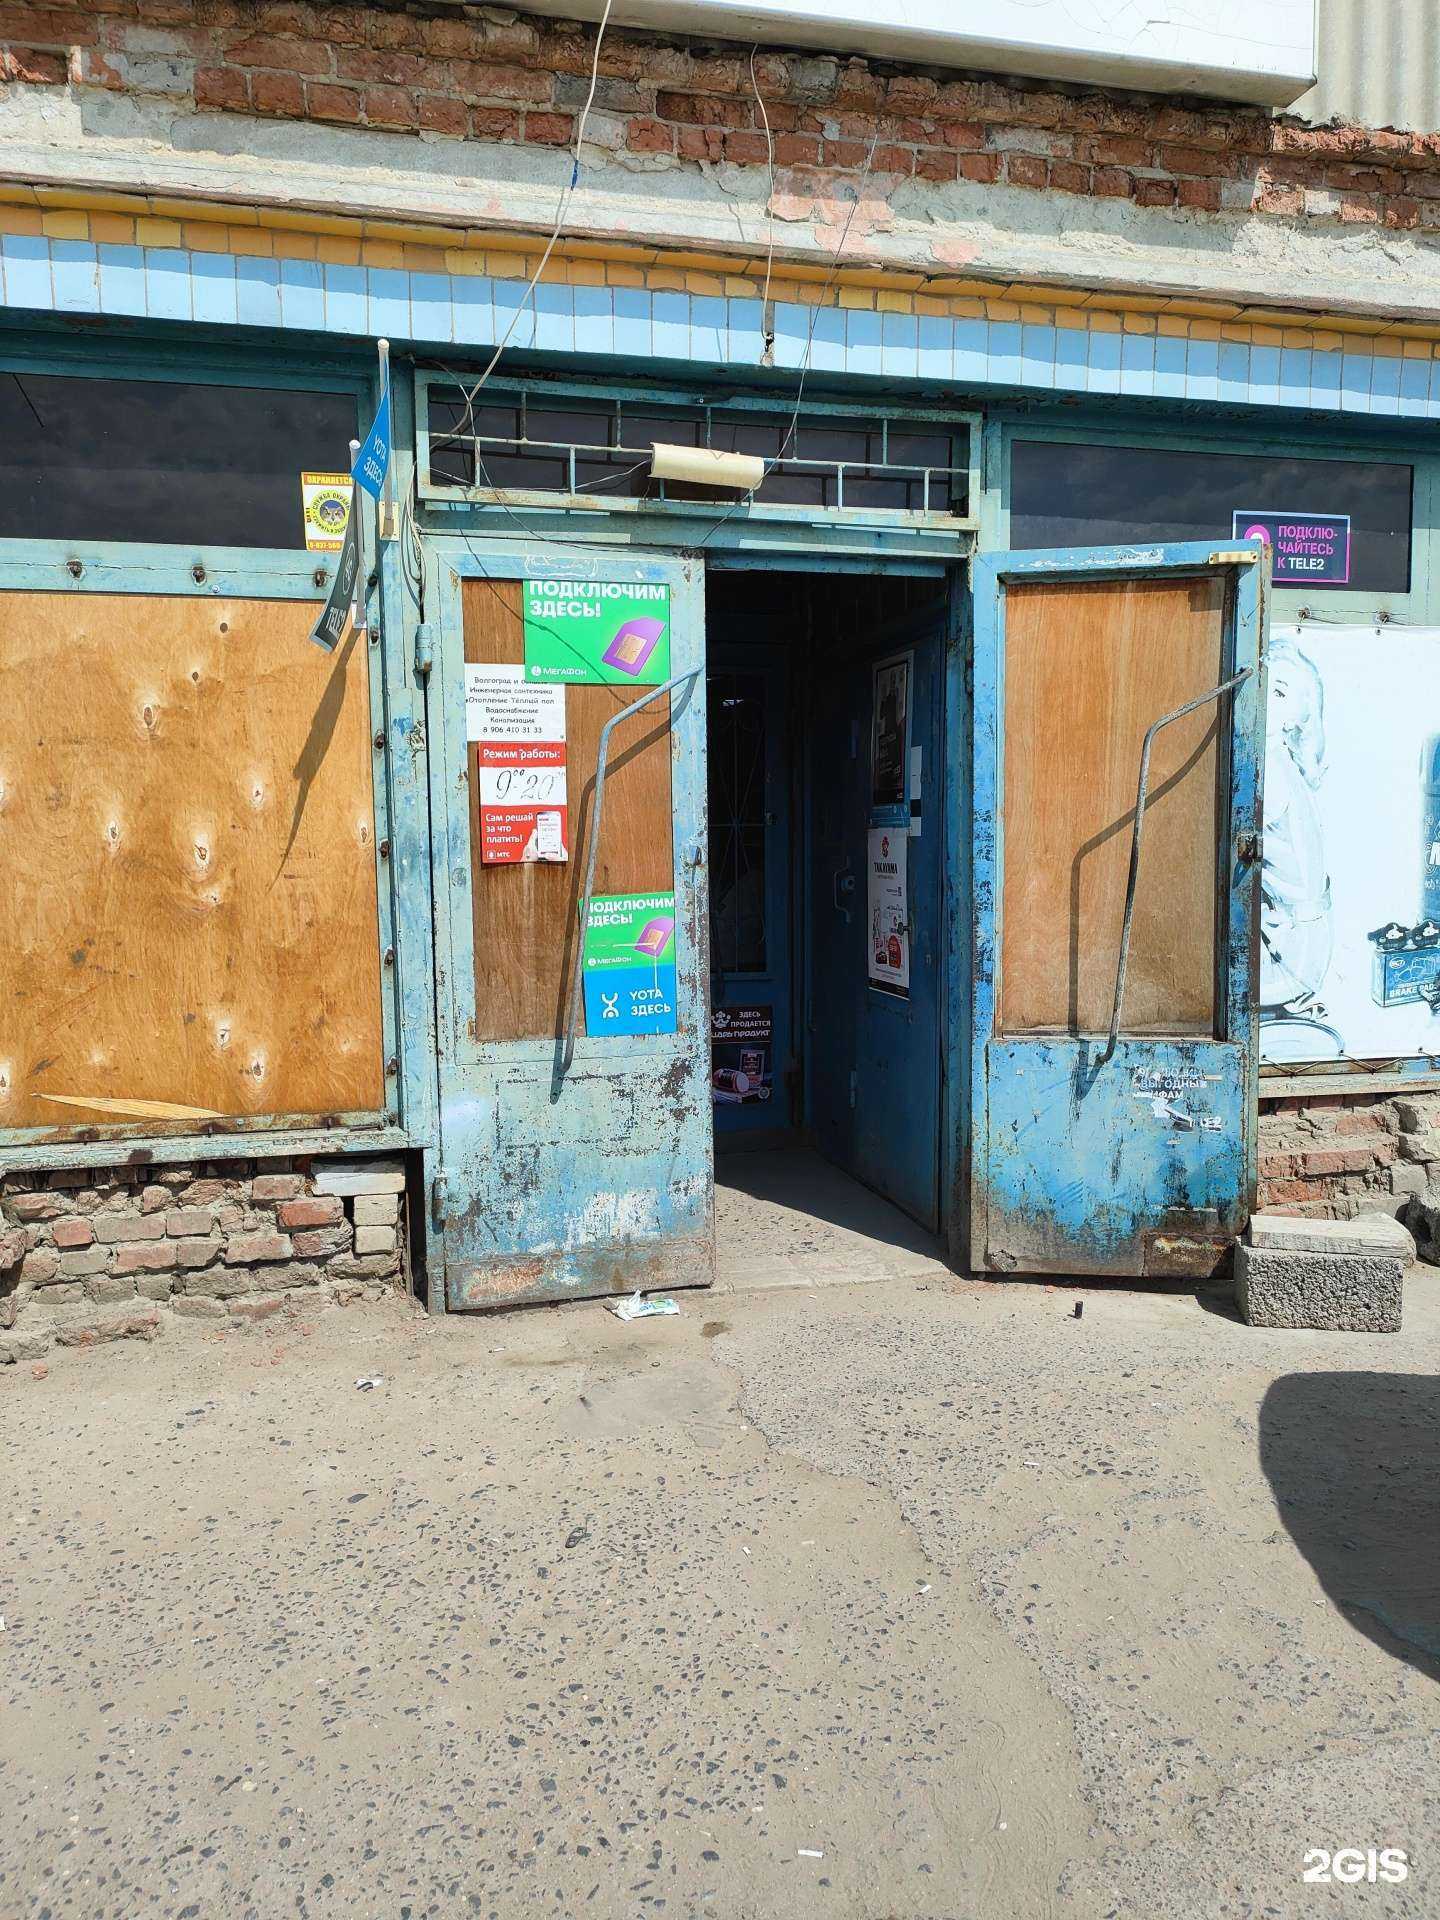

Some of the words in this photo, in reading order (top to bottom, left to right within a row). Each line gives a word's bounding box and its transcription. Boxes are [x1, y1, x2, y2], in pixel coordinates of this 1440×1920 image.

[1278, 525, 1338, 540] ПОДКЛЮ-
[1278, 540, 1334, 555] ЧАЙТЕСЬ
[1277, 557, 1286, 569] К
[1288, 557, 1325, 570] TELE2
[529, 580, 666, 600] ПОДКЛЮЧИМ
[529, 600, 602, 618] ЗДЕСЬ!
[474, 677, 512, 686] Волгоград
[469, 687, 512, 695] Инженерная
[468, 696, 508, 704] Отопление
[511, 696, 539, 704] Тёплый
[485, 706, 539, 714] Водоснабжение
[490, 717, 535, 725] Канализация
[483, 748, 517, 758] Режим
[520, 748, 561, 761] работы:
[485, 813, 503, 822] Сам
[505, 812, 534, 823] решай
[497, 825, 512, 833] что
[486, 834, 523, 843] платить!
[587, 913, 633, 928] ЗДЕСЬ!
[630, 988, 663, 1000] YOTA
[631, 1003, 672, 1017] ЗДЕСЬ
[730, 1020, 771, 1028] ПРОДАЕТСЯ
